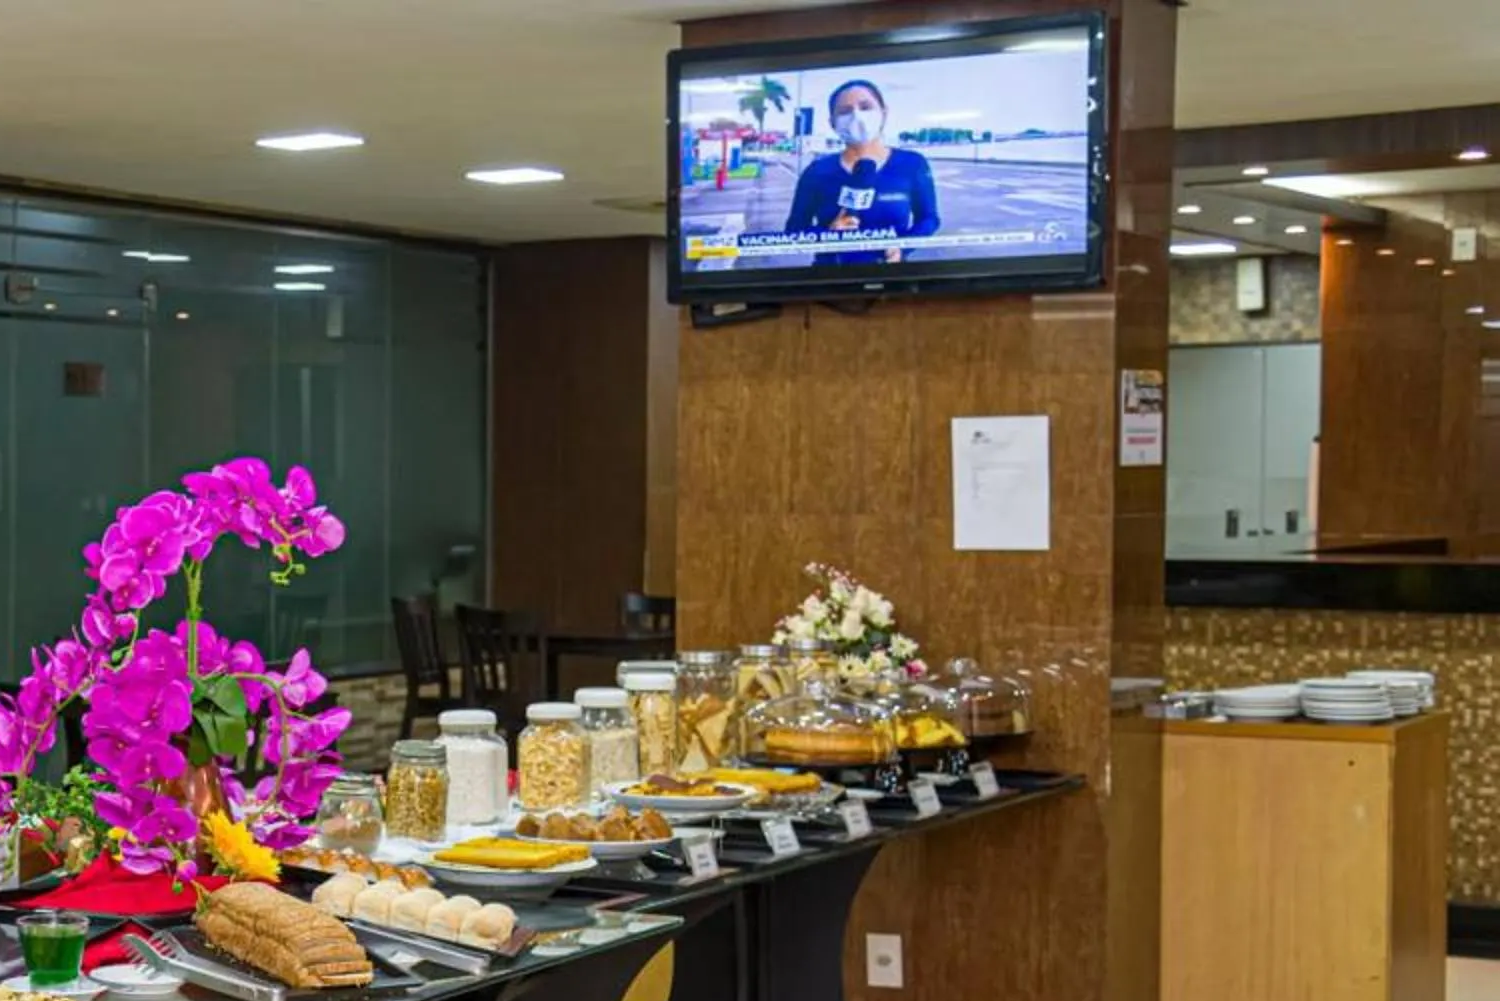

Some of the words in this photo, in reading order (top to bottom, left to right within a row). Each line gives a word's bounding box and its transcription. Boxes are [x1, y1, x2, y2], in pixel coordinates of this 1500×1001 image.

[741, 231, 817, 247] VACINAÇÃO
[820, 230, 840, 242] EM
[842, 226, 897, 241] MACAPÁ
